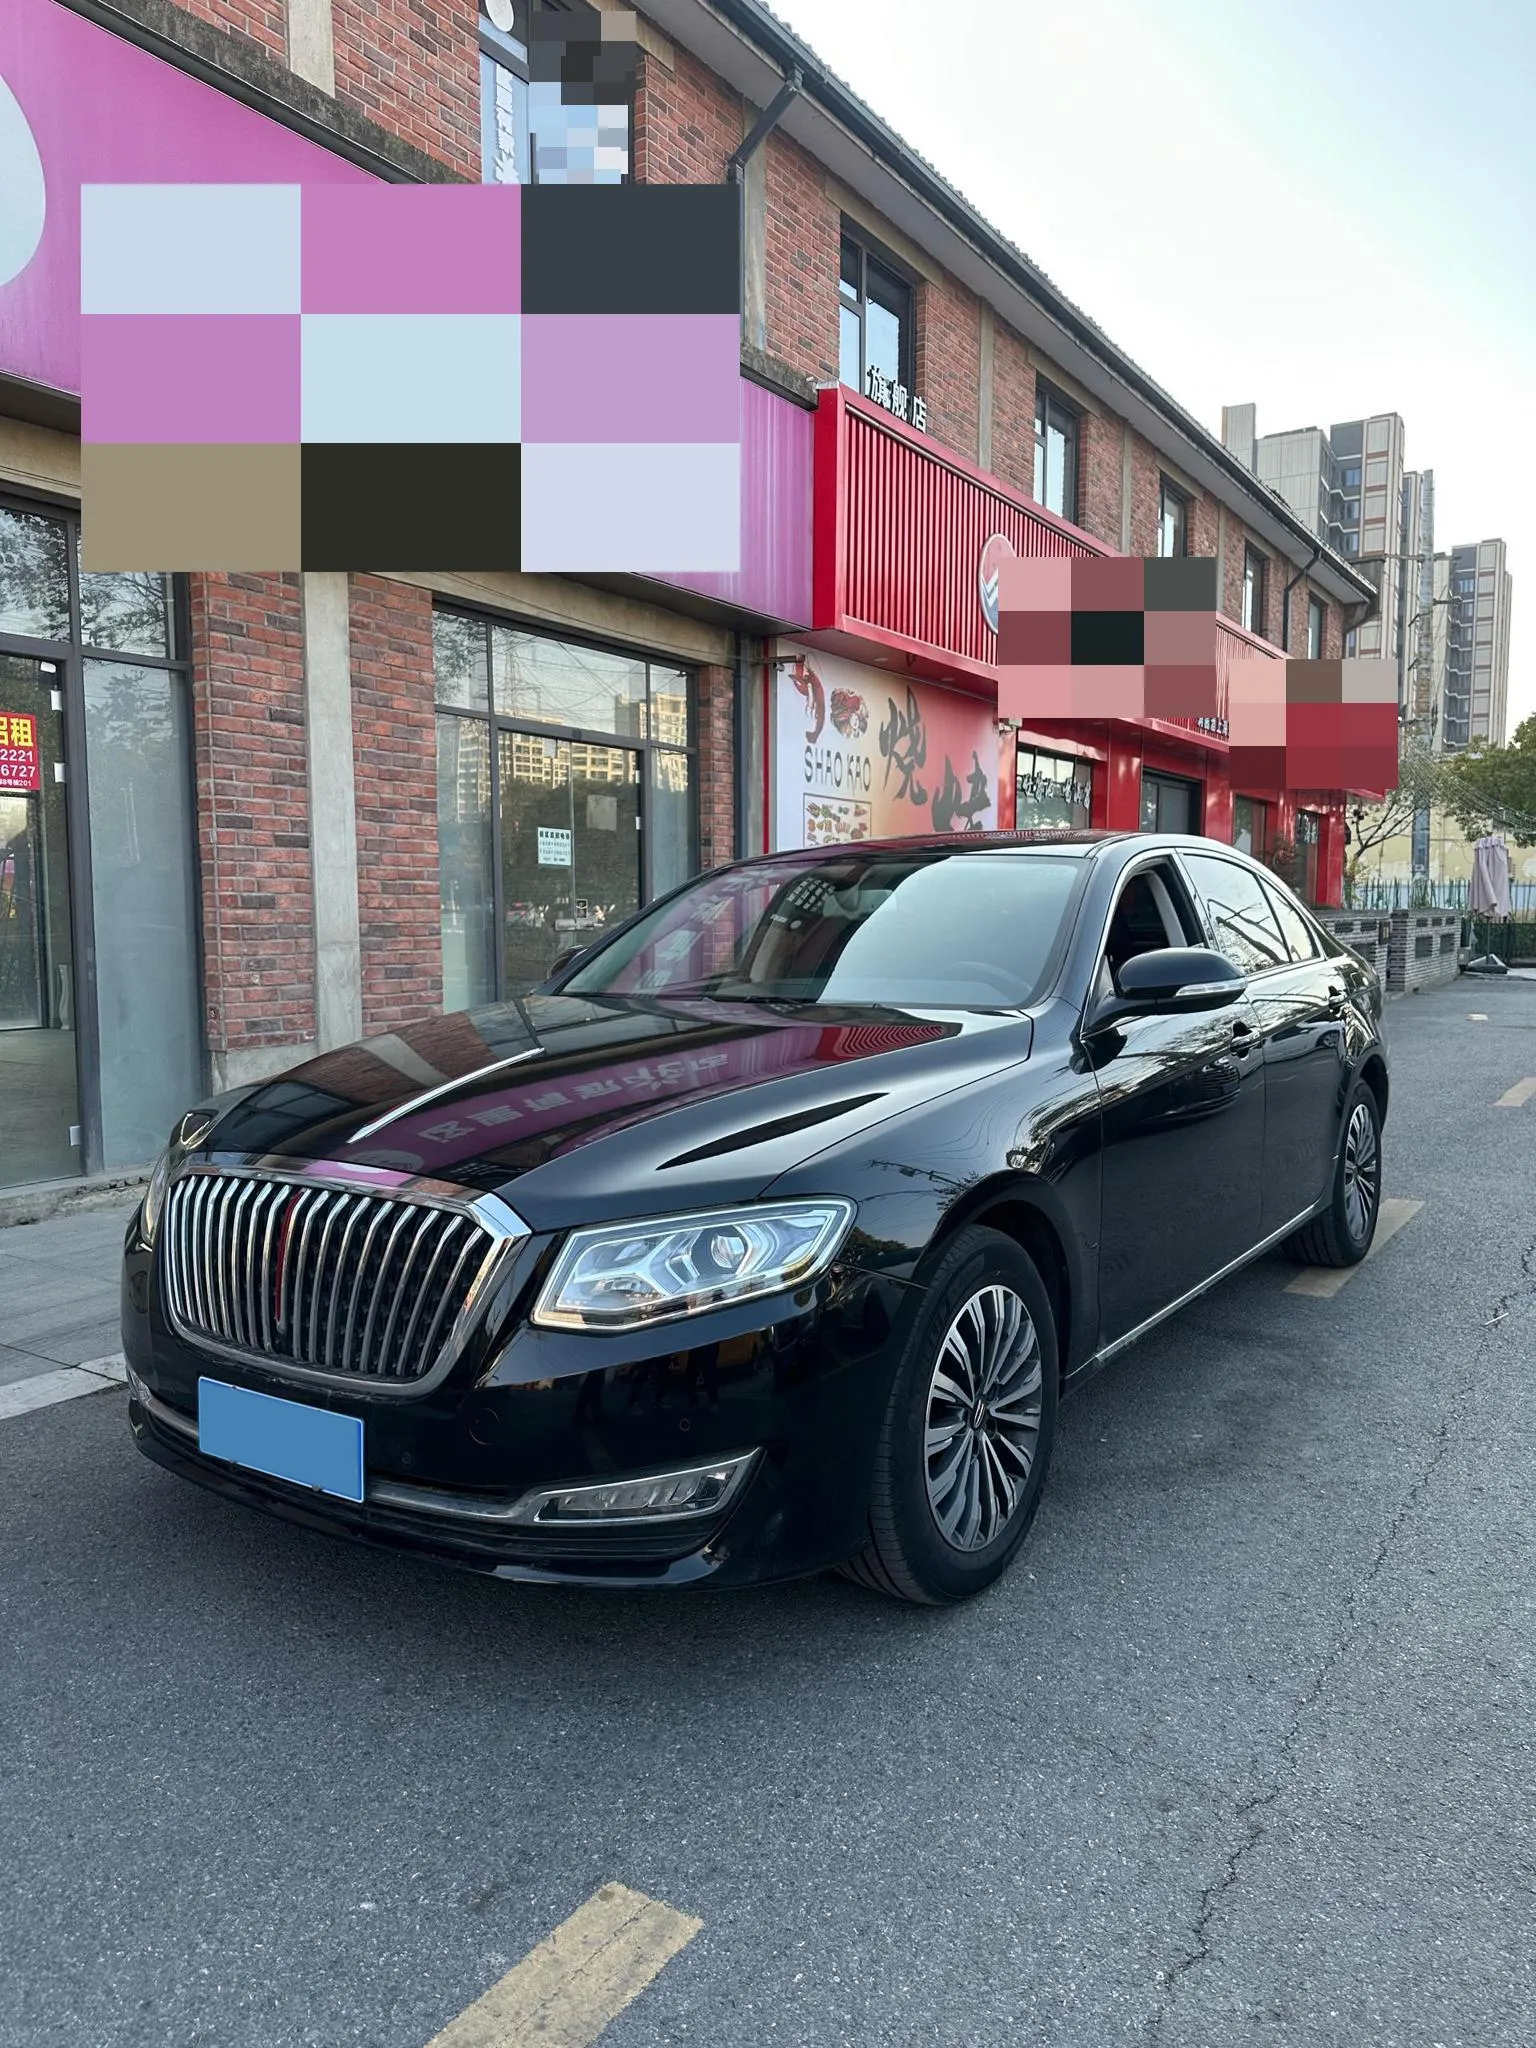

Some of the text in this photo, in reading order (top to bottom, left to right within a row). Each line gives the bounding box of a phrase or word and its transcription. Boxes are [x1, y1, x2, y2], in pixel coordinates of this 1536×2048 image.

[866, 365, 927, 433] 旗舰店
[1, 764, 35, 777] 6727
[804, 745, 871, 797] SHAO KAO
